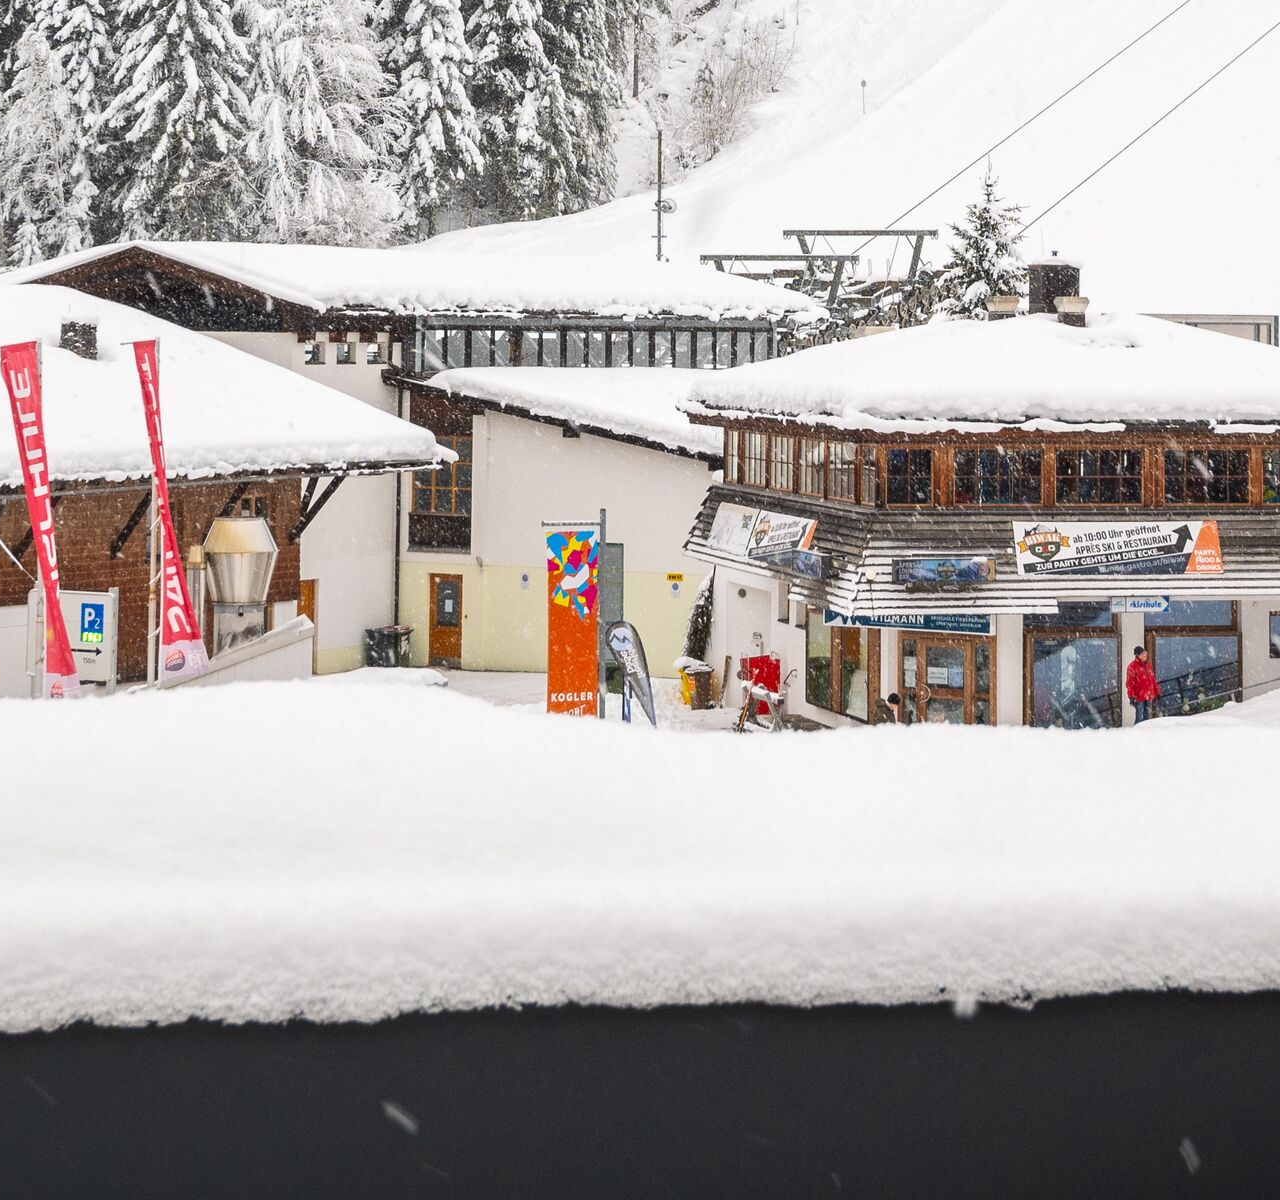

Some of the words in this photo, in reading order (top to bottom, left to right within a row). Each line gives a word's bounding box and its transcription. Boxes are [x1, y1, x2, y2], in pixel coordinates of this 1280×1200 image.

[1072, 534, 1083, 544] ab
[1084, 532, 1108, 542] 10:00
[1108, 530, 1124, 540] Uhr
[1125, 525, 1161, 539] geöffnet
[1102, 541, 1116, 552] SKI
[1117, 540, 1123, 550] &
[1124, 534, 1173, 549] RESTAURANT
[1036, 561, 1053, 571] ZUR
[1053, 558, 1080, 569] PARTY
[1081, 555, 1107, 565] GEHTS
[1108, 552, 1123, 562] UM
[1123, 550, 1137, 560] DIE
[551, 692, 593, 702] KOGLER
